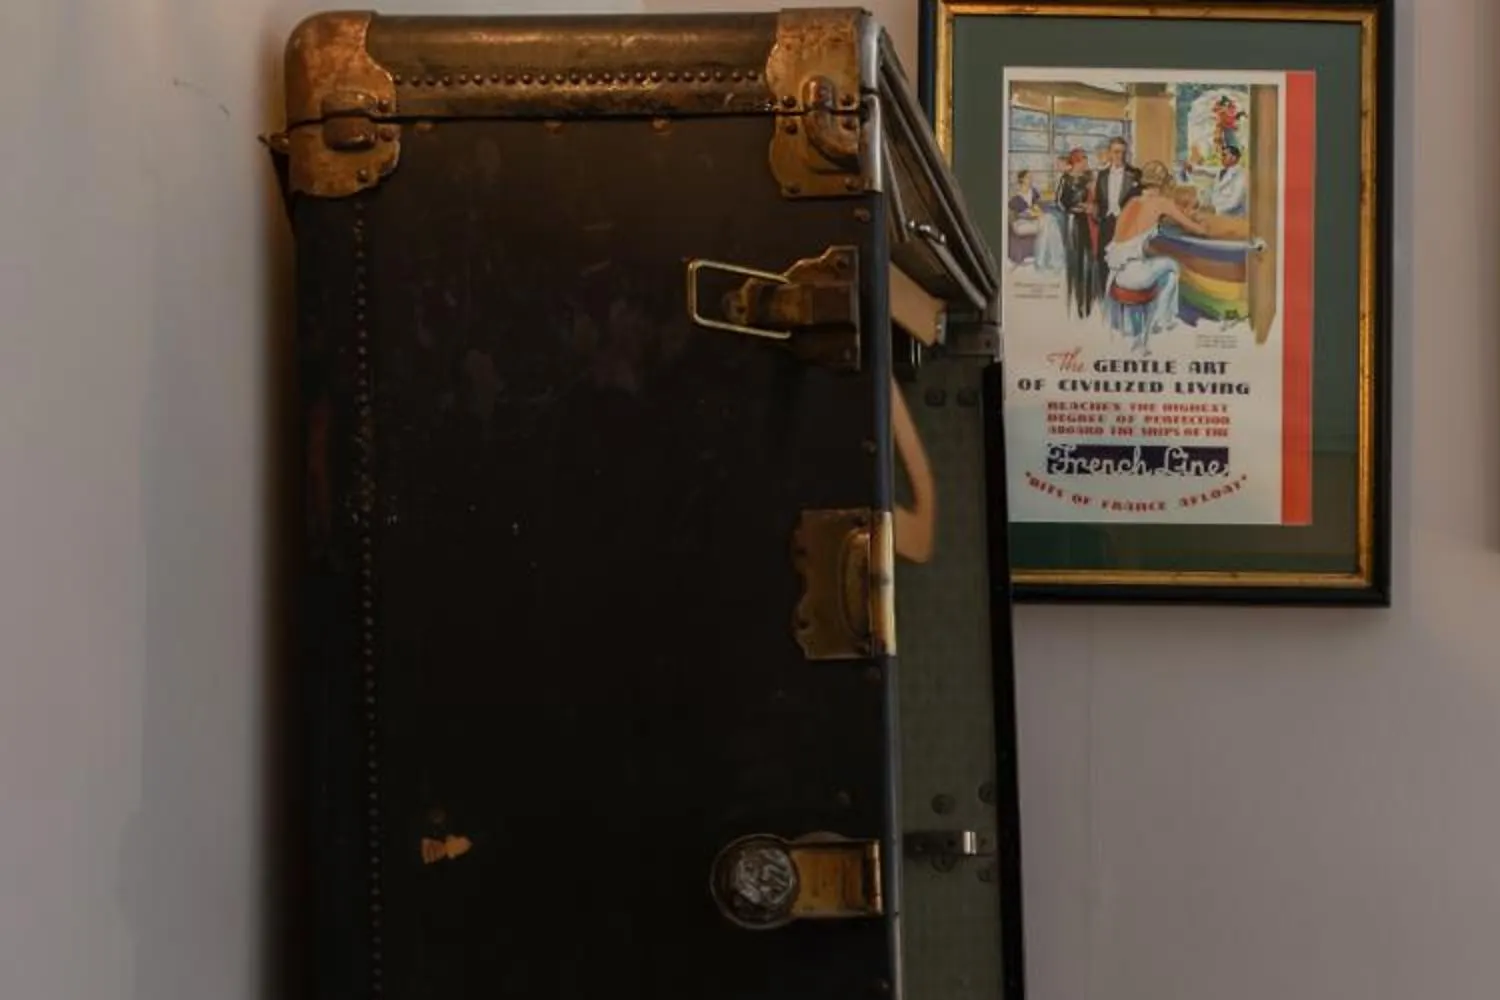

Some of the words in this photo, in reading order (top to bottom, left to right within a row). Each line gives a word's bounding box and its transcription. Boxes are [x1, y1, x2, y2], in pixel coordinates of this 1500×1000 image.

[1047, 346, 1085, 373] The
[1093, 359, 1177, 375] GENTLE
[1188, 360, 1230, 375] ART
[1017, 378, 1046, 392] OF
[1058, 379, 1164, 394] CIVILIZED
[1174, 381, 1250, 396] LIVING
[1048, 443, 1151, 477] French
[1154, 445, 1230, 478] Line
